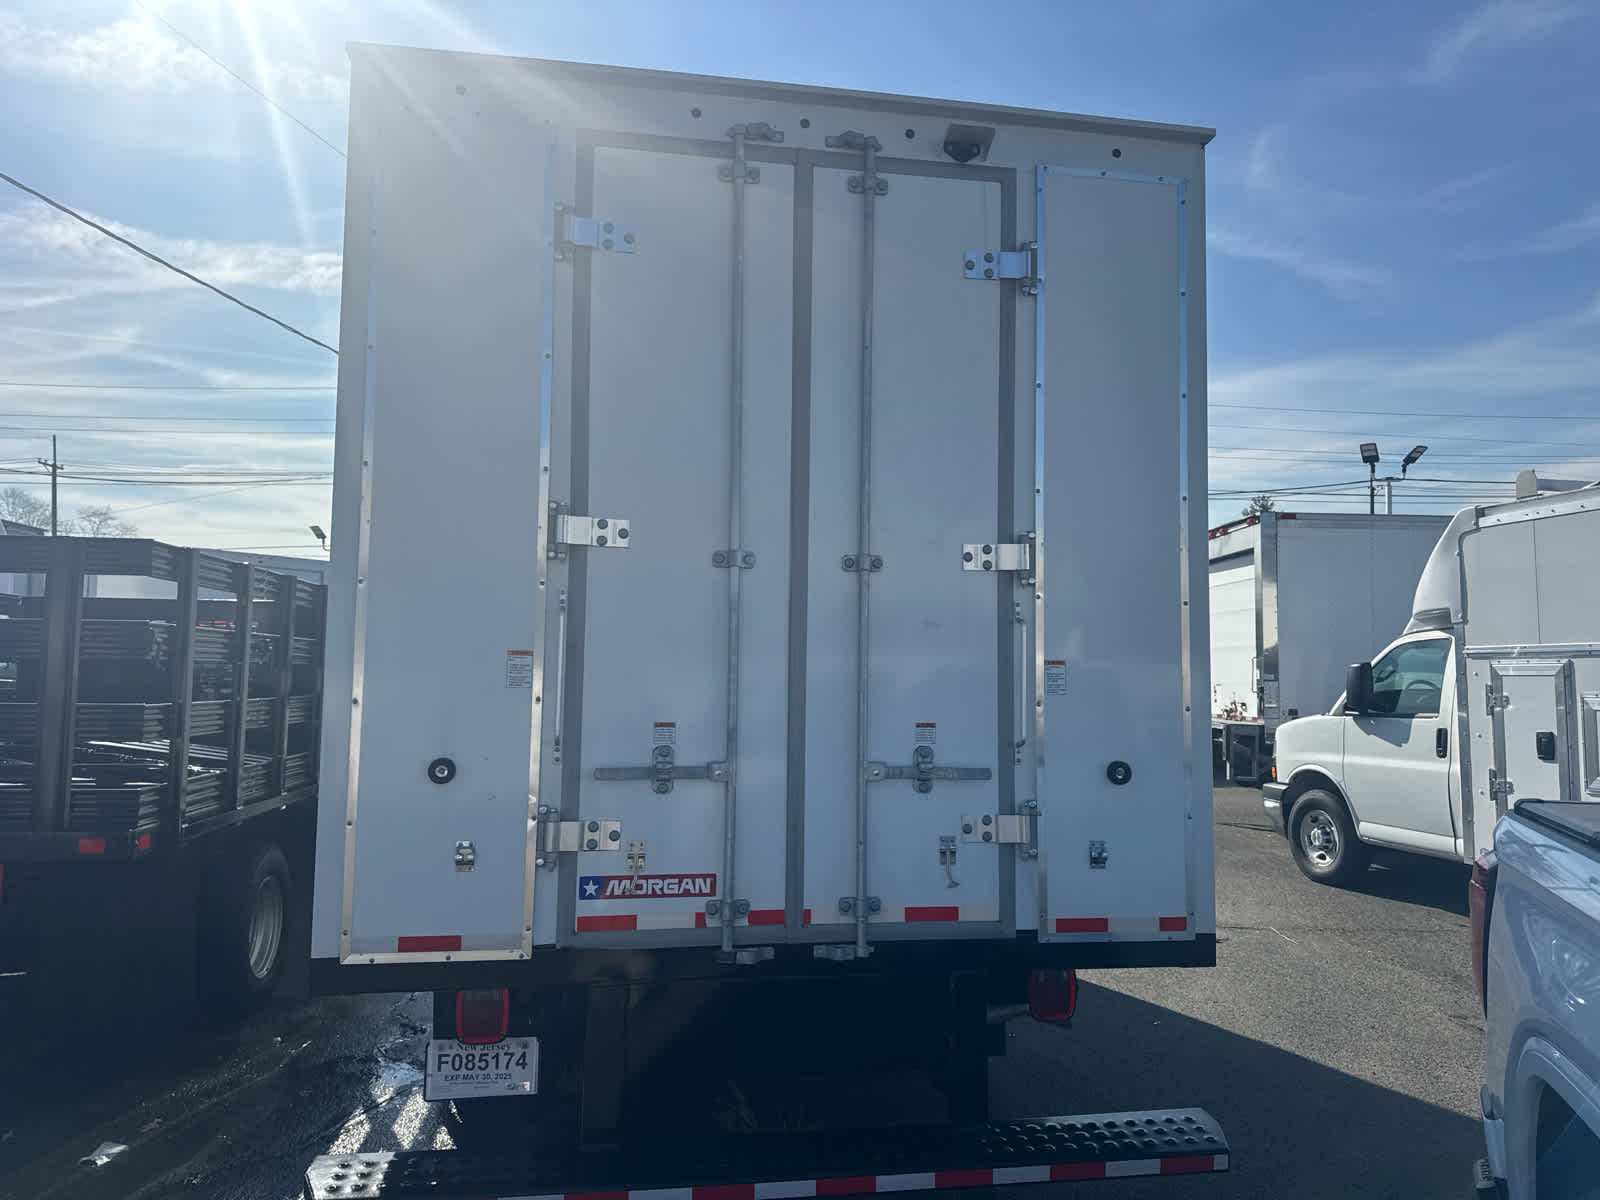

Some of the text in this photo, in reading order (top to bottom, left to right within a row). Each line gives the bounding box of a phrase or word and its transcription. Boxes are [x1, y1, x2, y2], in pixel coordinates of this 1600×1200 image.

[605, 877, 712, 897] MORGAN
[437, 1051, 529, 1073] F085174
[444, 1073, 461, 1082] EXP
[463, 1073, 480, 1081] MAY
[495, 1072, 513, 1080] 2025
